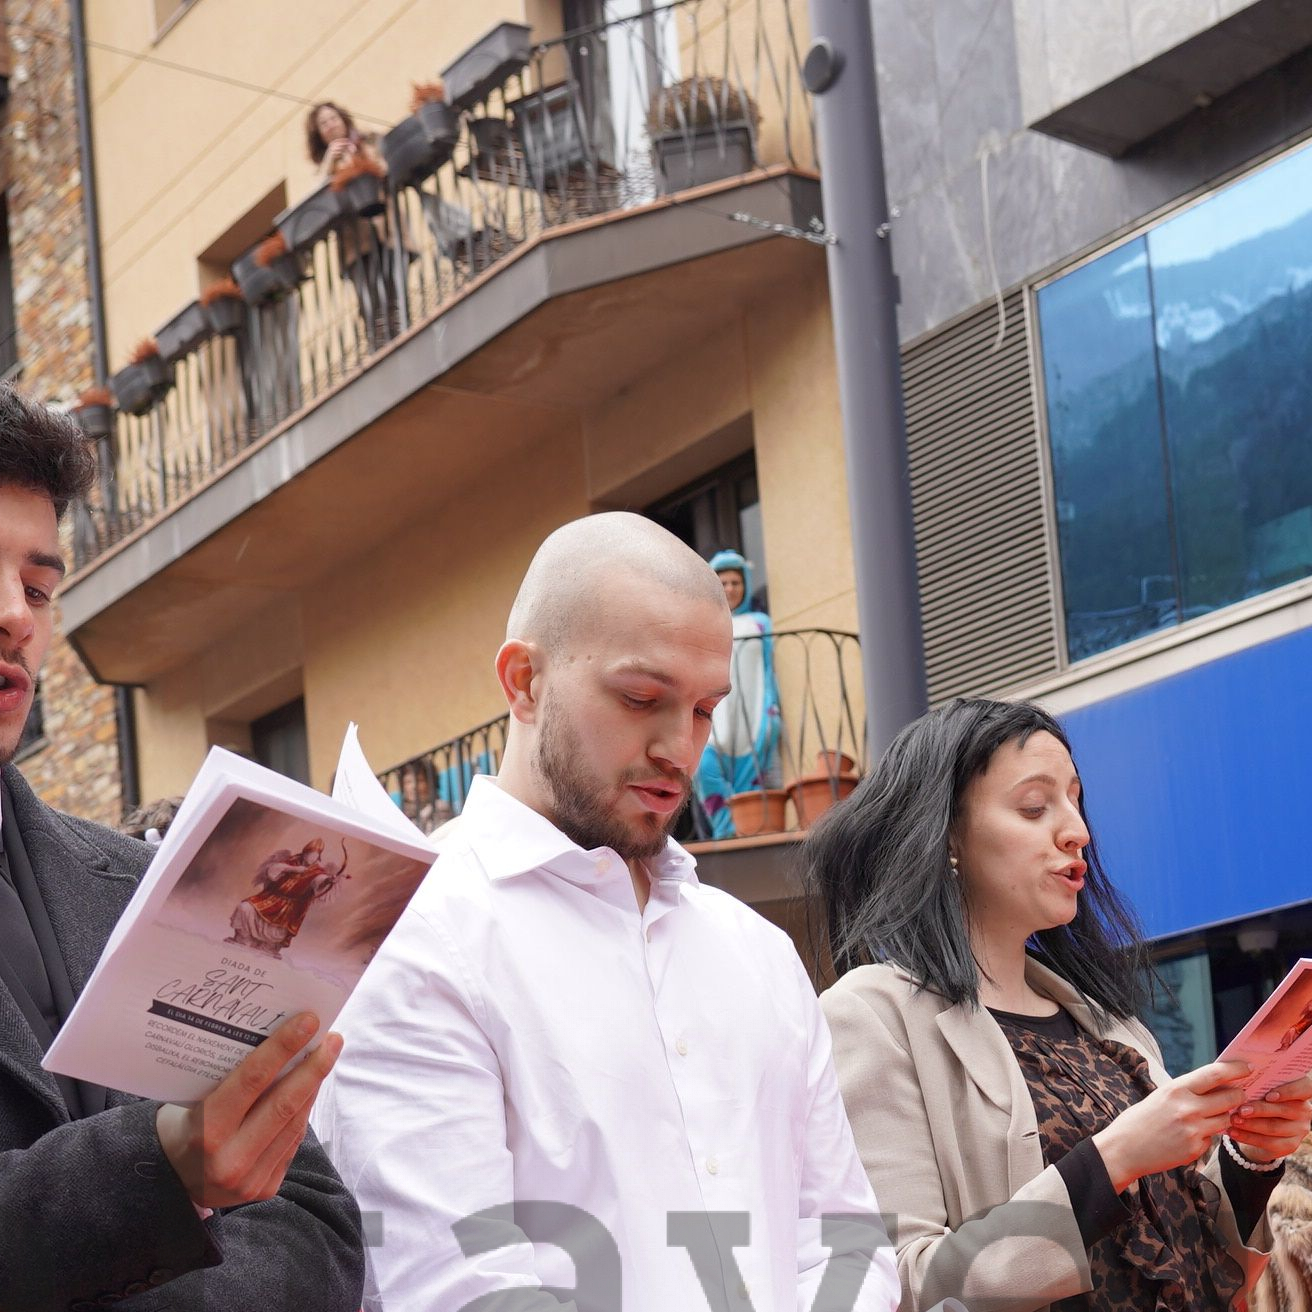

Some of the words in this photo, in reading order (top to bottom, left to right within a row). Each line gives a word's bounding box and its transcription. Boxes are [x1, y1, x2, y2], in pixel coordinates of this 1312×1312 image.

[220, 957, 251, 973] DIADA
[254, 967, 267, 978] DE
[202, 969, 274, 999] SANT
[147, 1019, 188, 1037] RECORDEM
